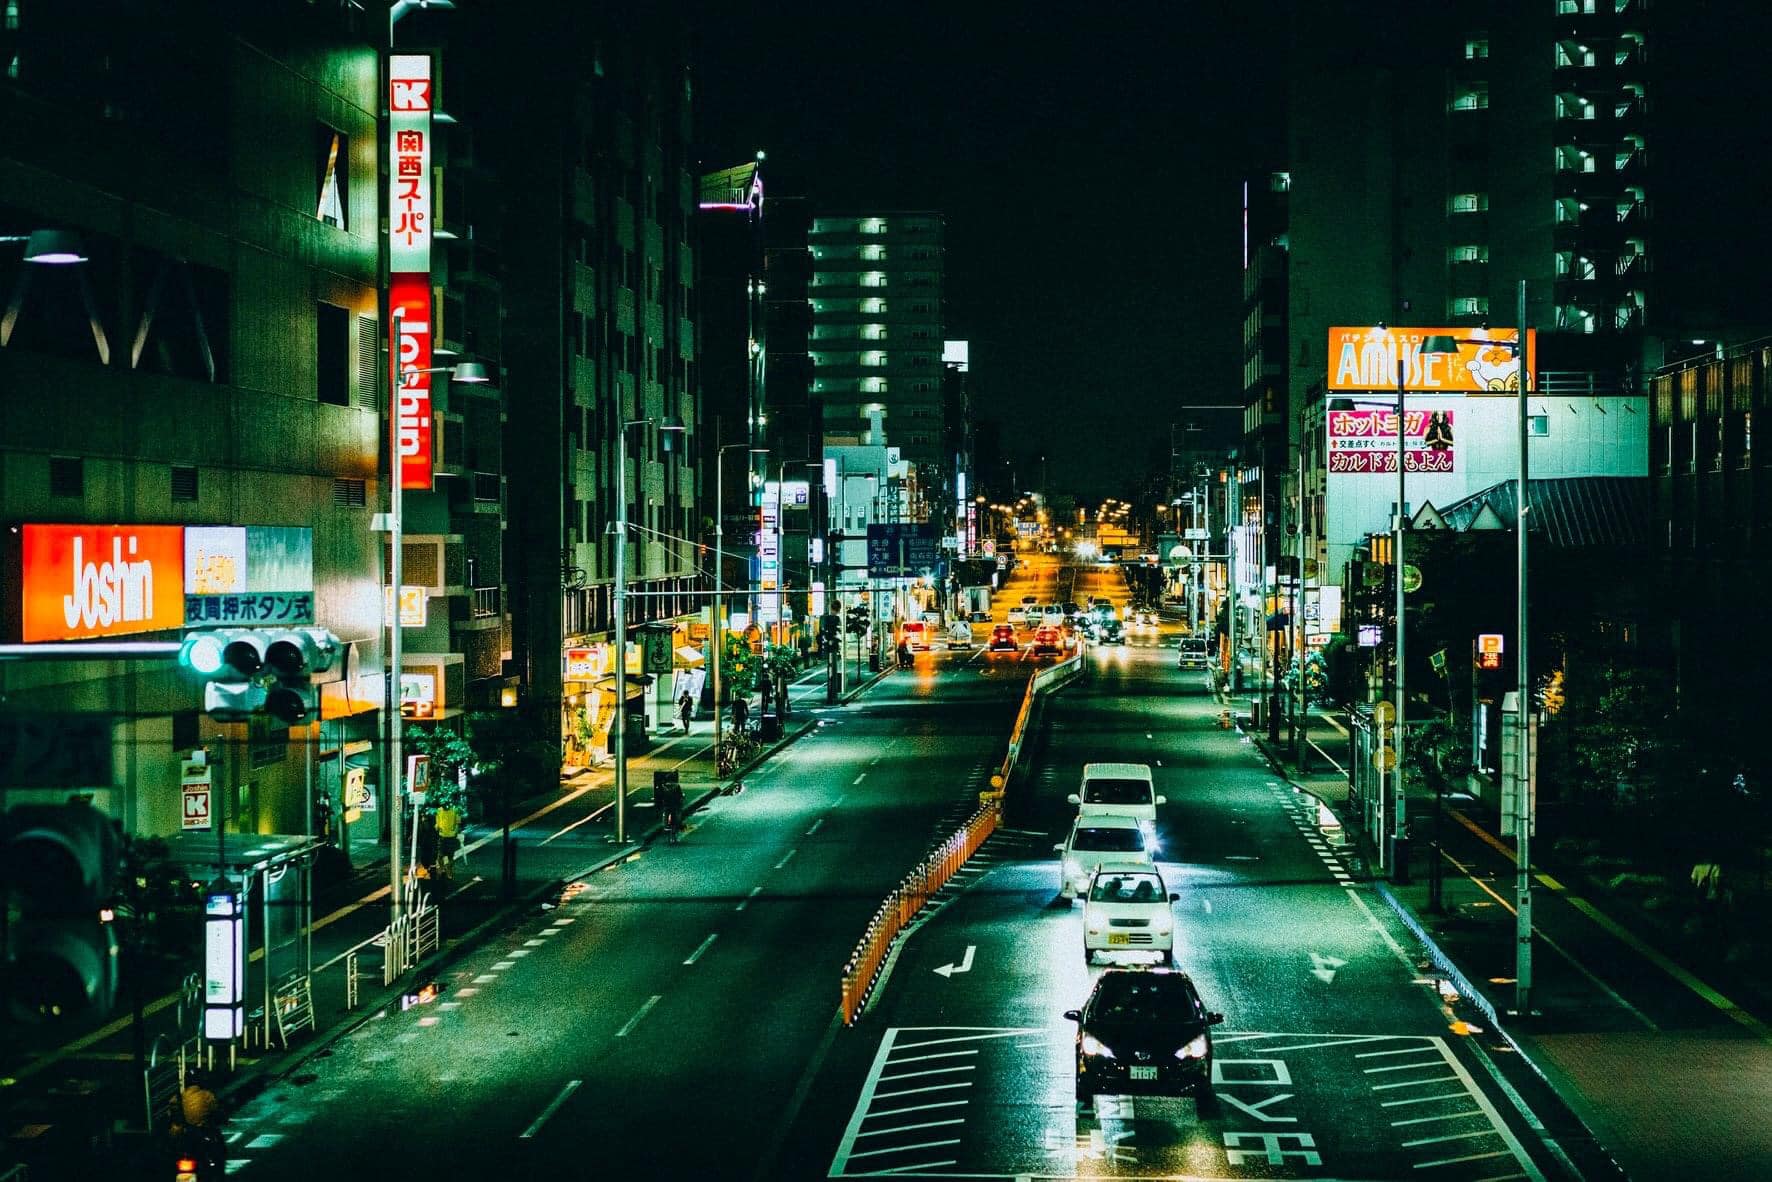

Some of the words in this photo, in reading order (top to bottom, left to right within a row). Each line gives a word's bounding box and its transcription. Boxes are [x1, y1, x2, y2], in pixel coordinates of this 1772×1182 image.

[395, 130, 424, 246] 関西スーパー
[393, 307, 430, 456] Joshin
[1336, 342, 1441, 387] AMUSE
[64, 536, 153, 629] Joshin
[187, 595, 312, 621] 夜間押ボタン式
[1484, 637, 1499, 651] P
[416, 702, 432, 716] P
